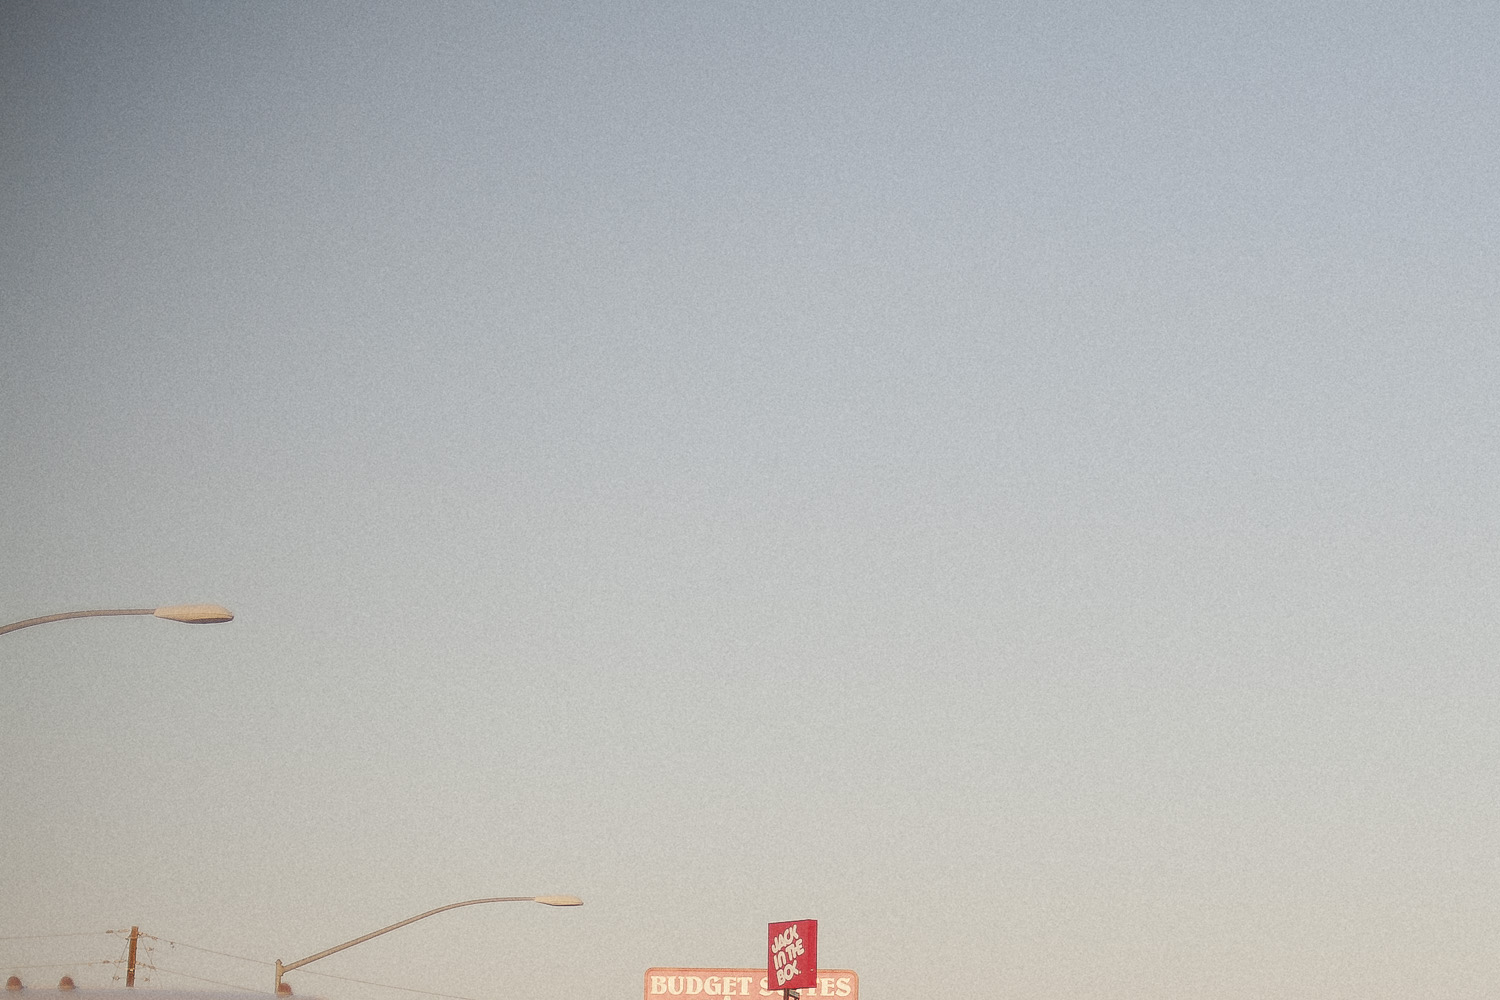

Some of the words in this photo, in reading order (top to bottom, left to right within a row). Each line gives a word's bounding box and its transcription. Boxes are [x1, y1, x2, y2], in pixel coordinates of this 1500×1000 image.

[772, 924, 799, 954] JACK
[785, 938, 805, 961] THE
[651, 976, 752, 996] BUDGET
[759, 977, 852, 997] SES
